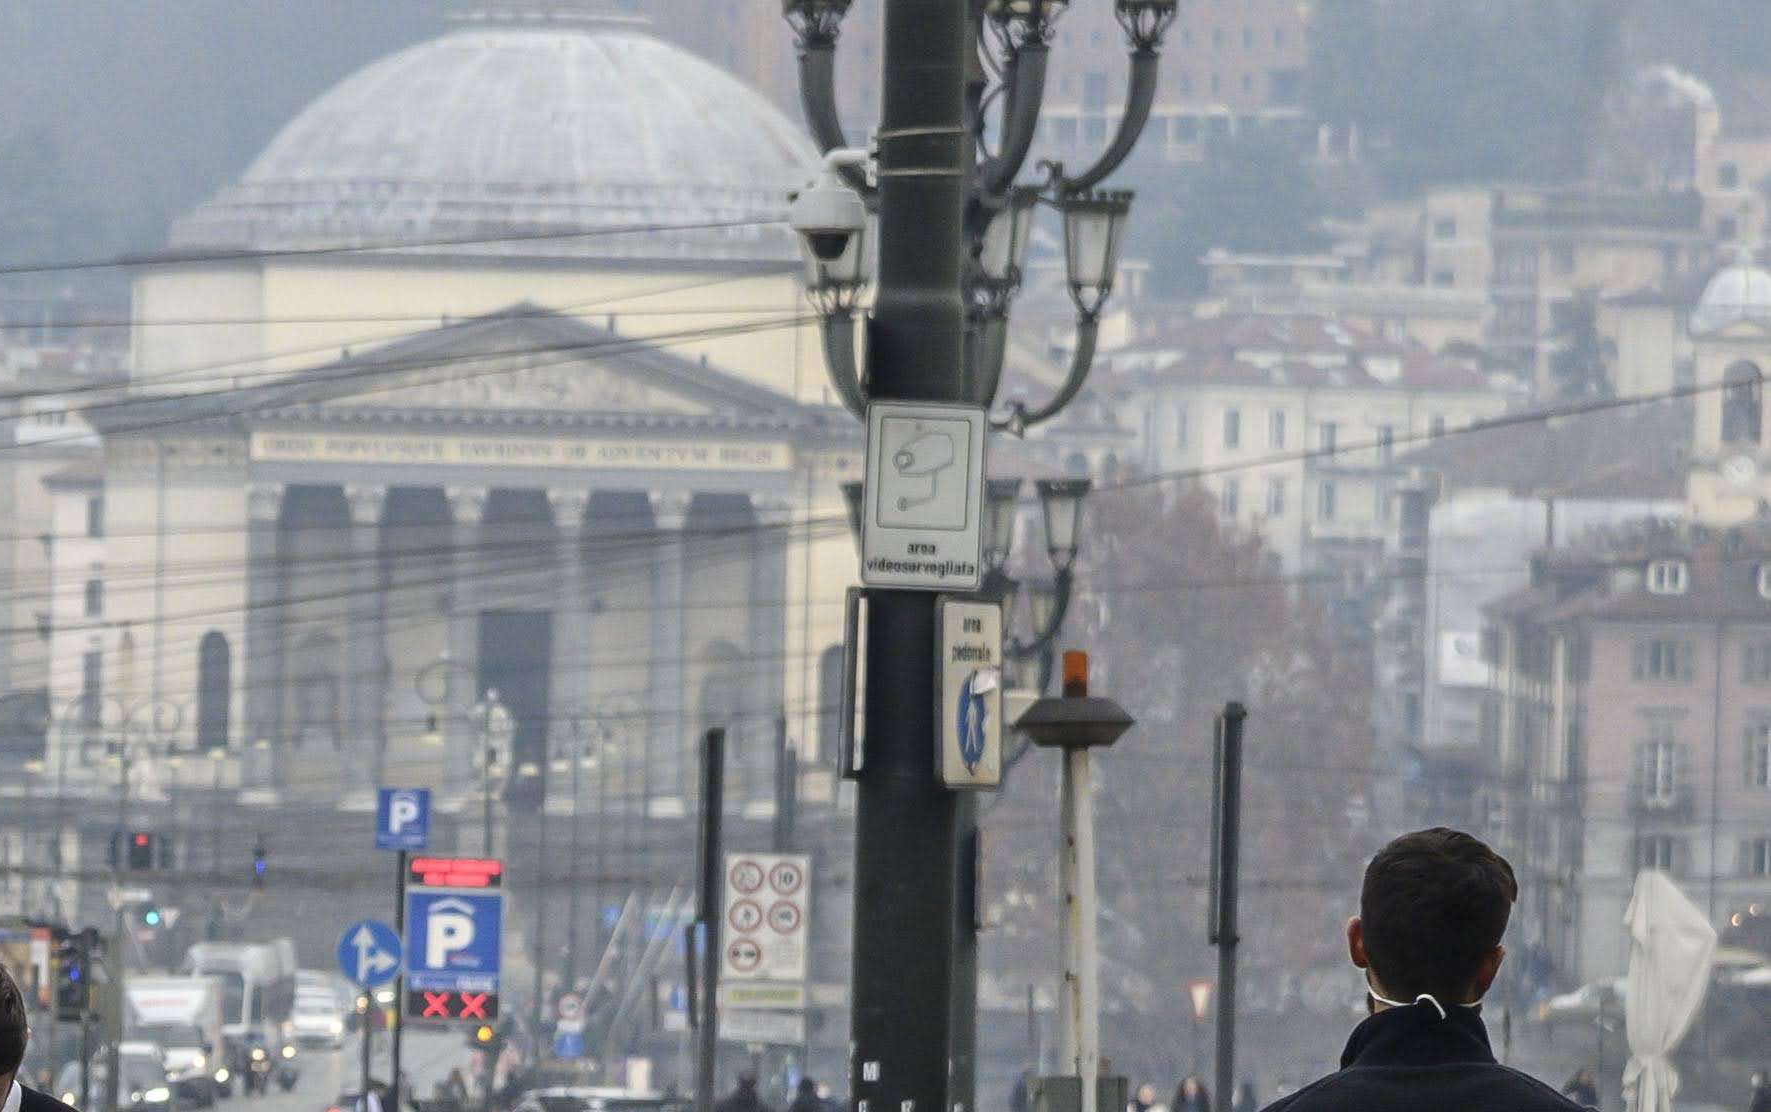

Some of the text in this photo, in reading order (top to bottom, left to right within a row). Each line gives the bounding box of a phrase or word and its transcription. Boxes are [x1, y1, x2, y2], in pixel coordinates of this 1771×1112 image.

[907, 543, 937, 556] area
[866, 558, 975, 578] videosorvegliata
[962, 617, 982, 634] area
[389, 799, 419, 834] P
[425, 913, 476, 969] P
[863, 1060, 881, 1082] M
